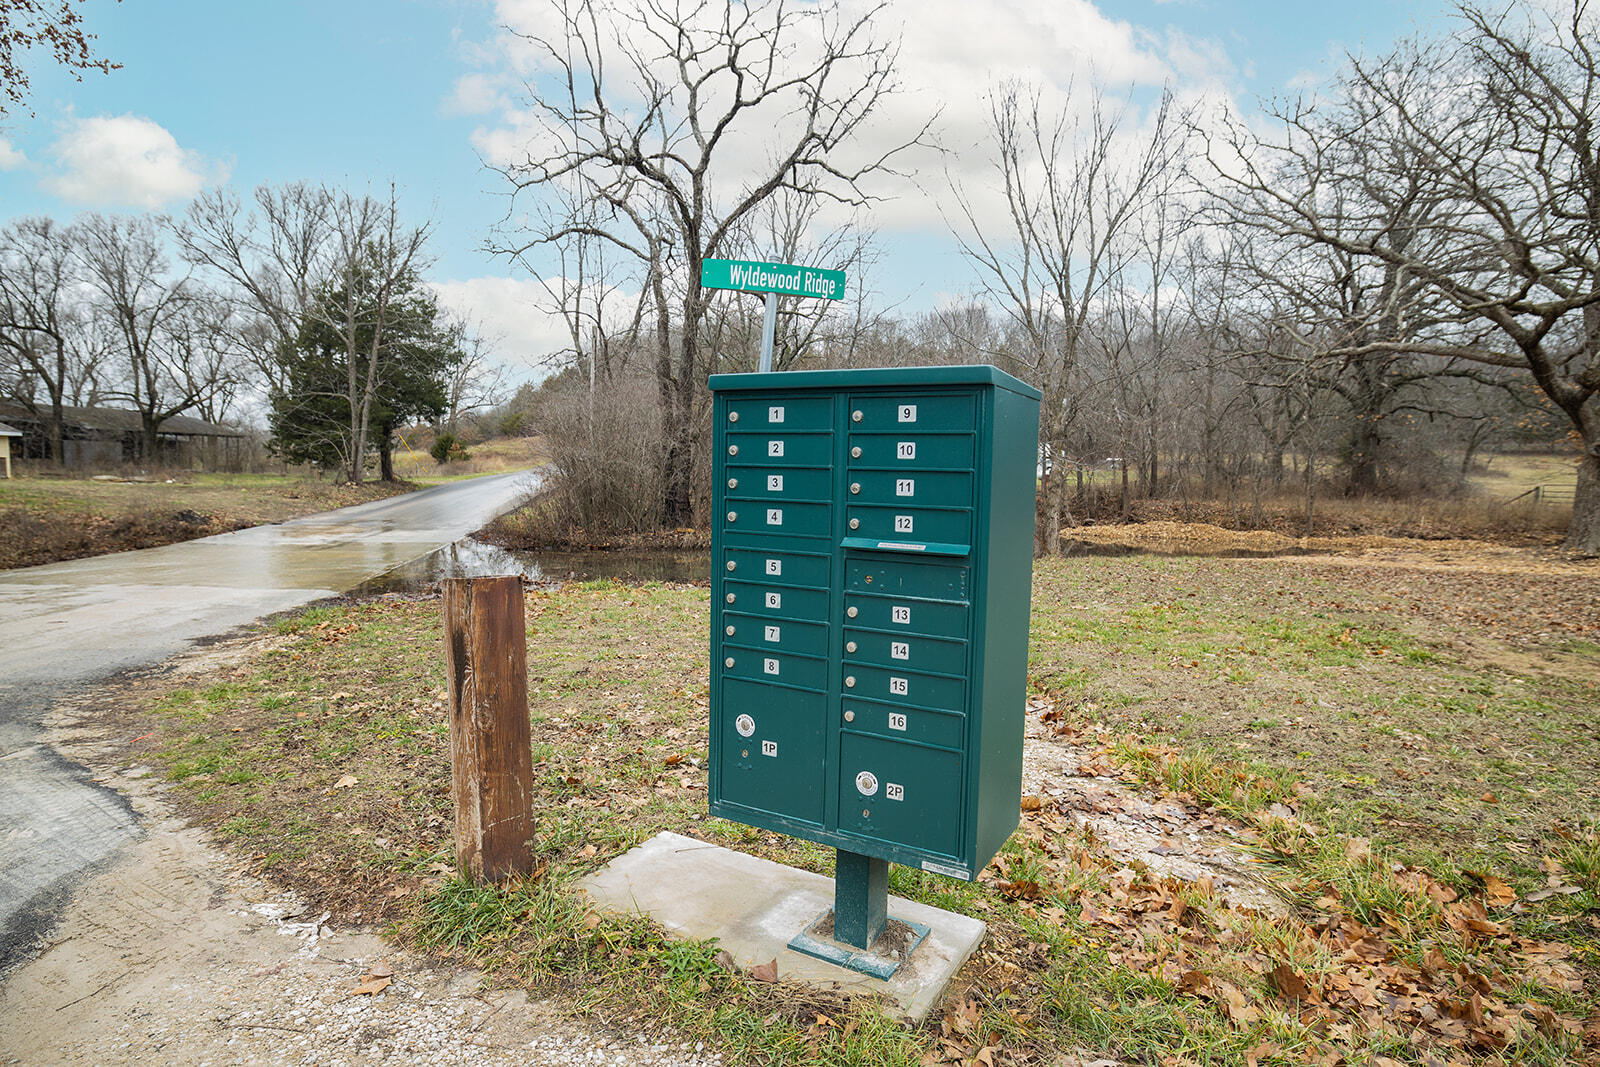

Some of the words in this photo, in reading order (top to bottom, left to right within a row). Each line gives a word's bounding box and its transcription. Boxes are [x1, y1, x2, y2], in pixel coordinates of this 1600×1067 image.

[730, 264, 801, 291] Wyldewood
[804, 272, 836, 298] Ridge
[773, 410, 779, 420] 1
[903, 408, 911, 419] 9
[773, 444, 780, 454] 2
[899, 445, 914, 456] 10
[772, 478, 779, 488] 3
[898, 482, 911, 493] 11
[771, 512, 778, 522] 4
[897, 518, 911, 529] 12
[770, 562, 777, 572] 5
[770, 595, 777, 605] 6
[895, 609, 908, 621] 13
[769, 628, 776, 638] 7
[894, 645, 907, 656] 14
[768, 661, 775, 671] 8
[893, 680, 906, 692] 15
[891, 716, 905, 728] 16
[763, 742, 776, 753] 1P
[888, 785, 903, 797] 2P
